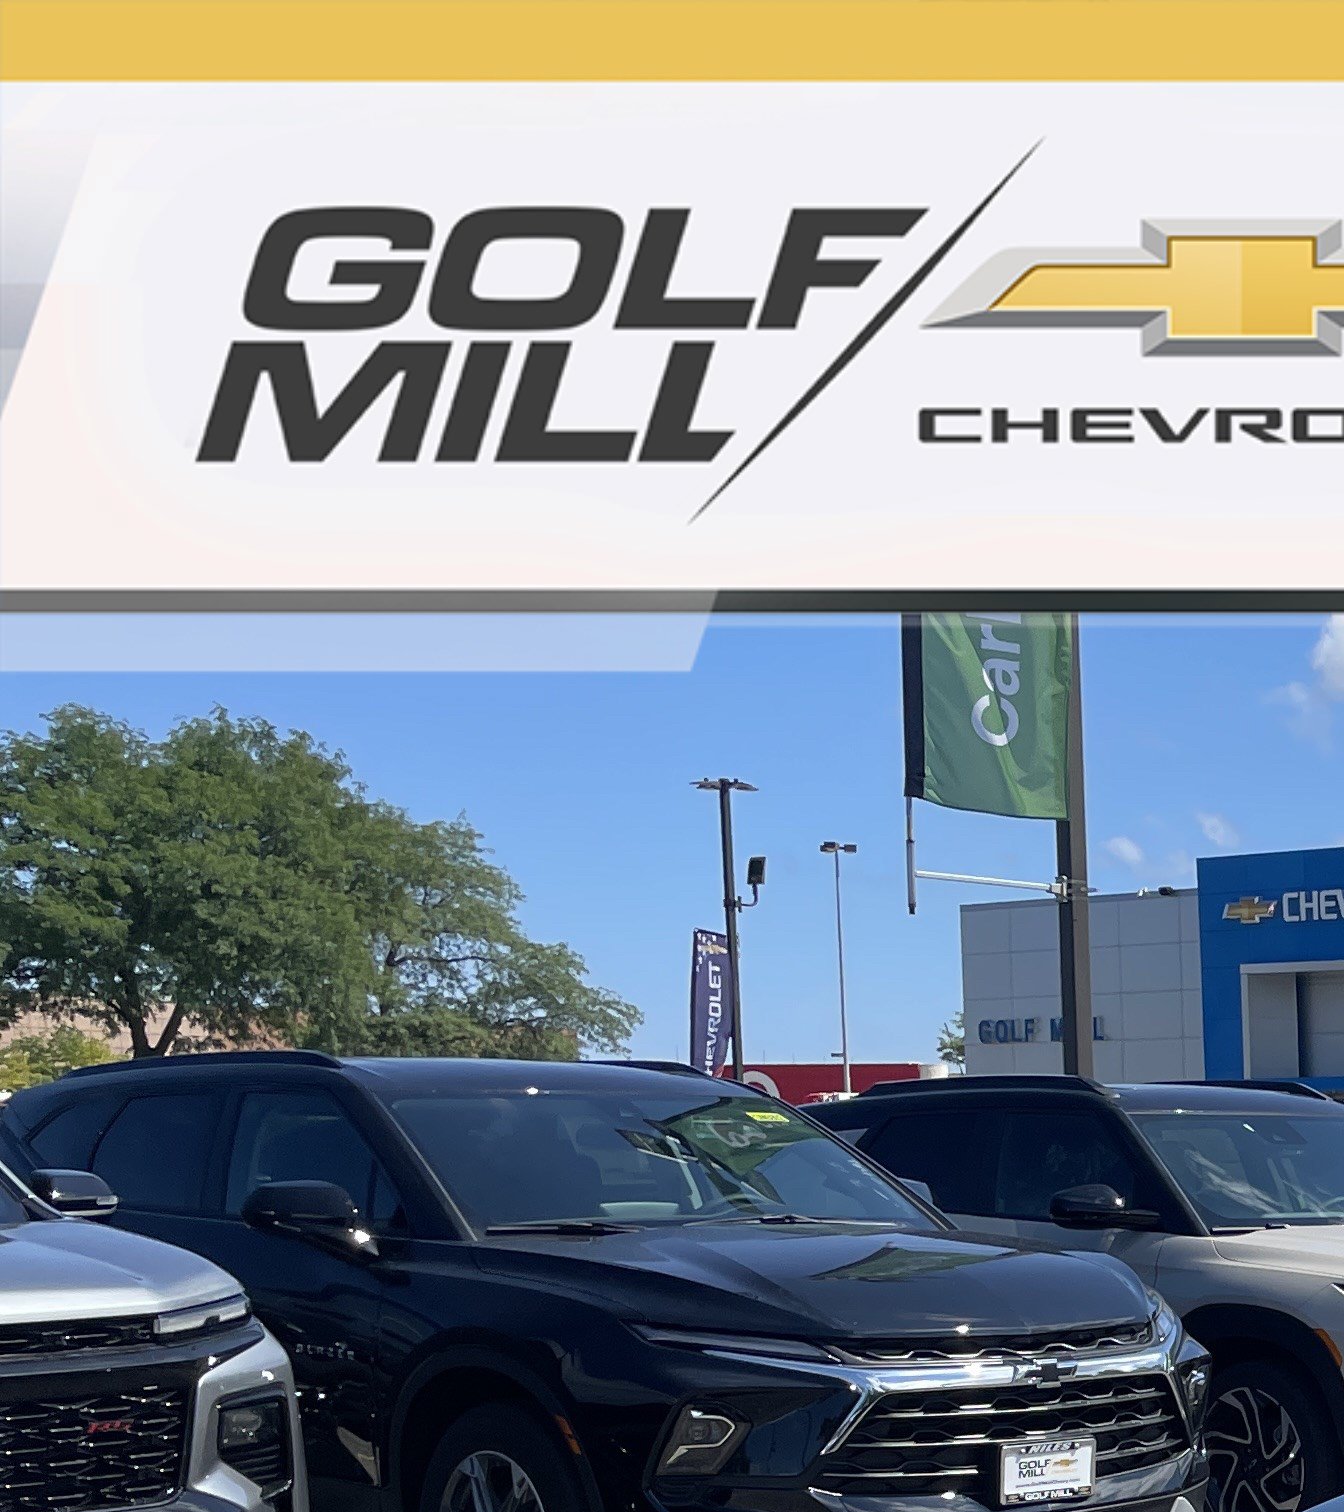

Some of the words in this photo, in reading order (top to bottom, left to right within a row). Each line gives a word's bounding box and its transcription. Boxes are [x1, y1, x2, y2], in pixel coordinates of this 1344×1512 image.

[970, 612, 1021, 747] Car
[704, 960, 723, 1077] HEVROLET
[978, 1018, 1035, 1044] GOLF
[1050, 1017, 1105, 1042] ML
[1018, 1459, 1051, 1470] GOLF
[1018, 1468, 1046, 1479] MILL
[1025, 1492, 1050, 1501] GOLF
[1051, 1489, 1073, 1498] MILL
